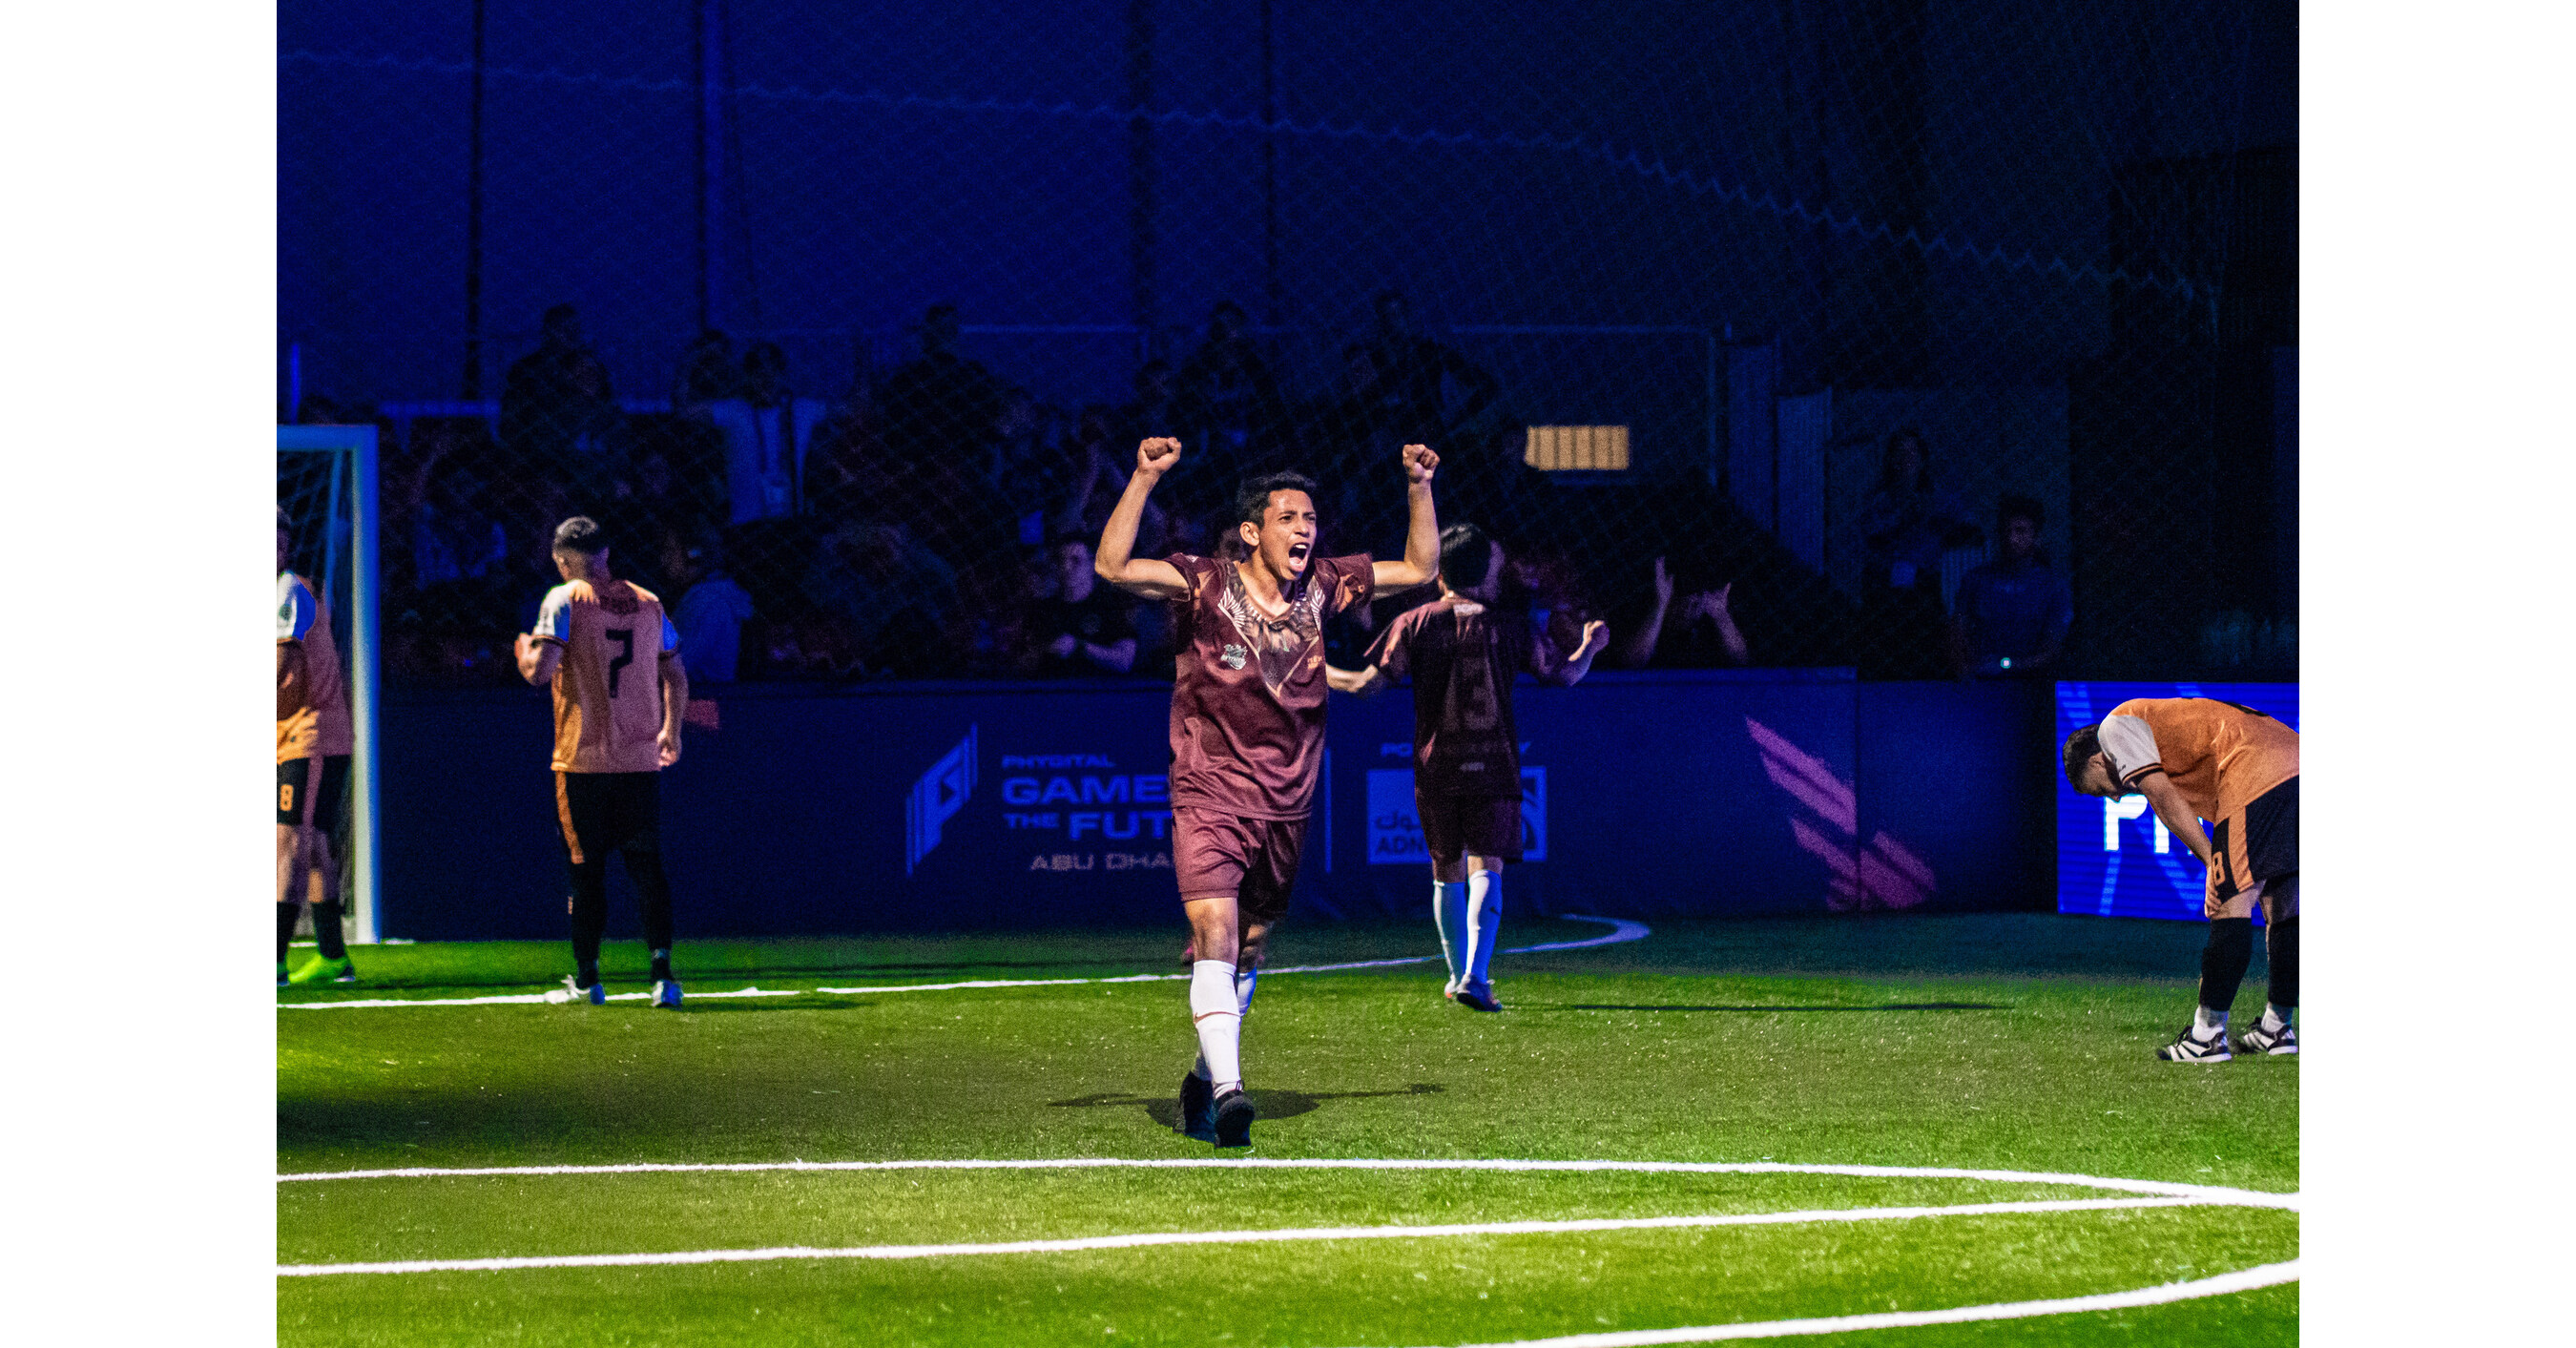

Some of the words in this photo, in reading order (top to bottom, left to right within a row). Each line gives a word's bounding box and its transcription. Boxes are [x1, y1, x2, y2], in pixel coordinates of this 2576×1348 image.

[605, 630, 634, 699] 7
[1001, 754, 1116, 769] PHYGITAL
[279, 783, 295, 813] 8
[1002, 774, 1169, 806] GAME
[1003, 811, 1061, 829] THE
[1068, 809, 1173, 841] FUT
[1028, 852, 1094, 871] ABU
[1105, 851, 1172, 870] DHA
[1375, 836, 1424, 855] ADN
[2211, 850, 2226, 887] 8
